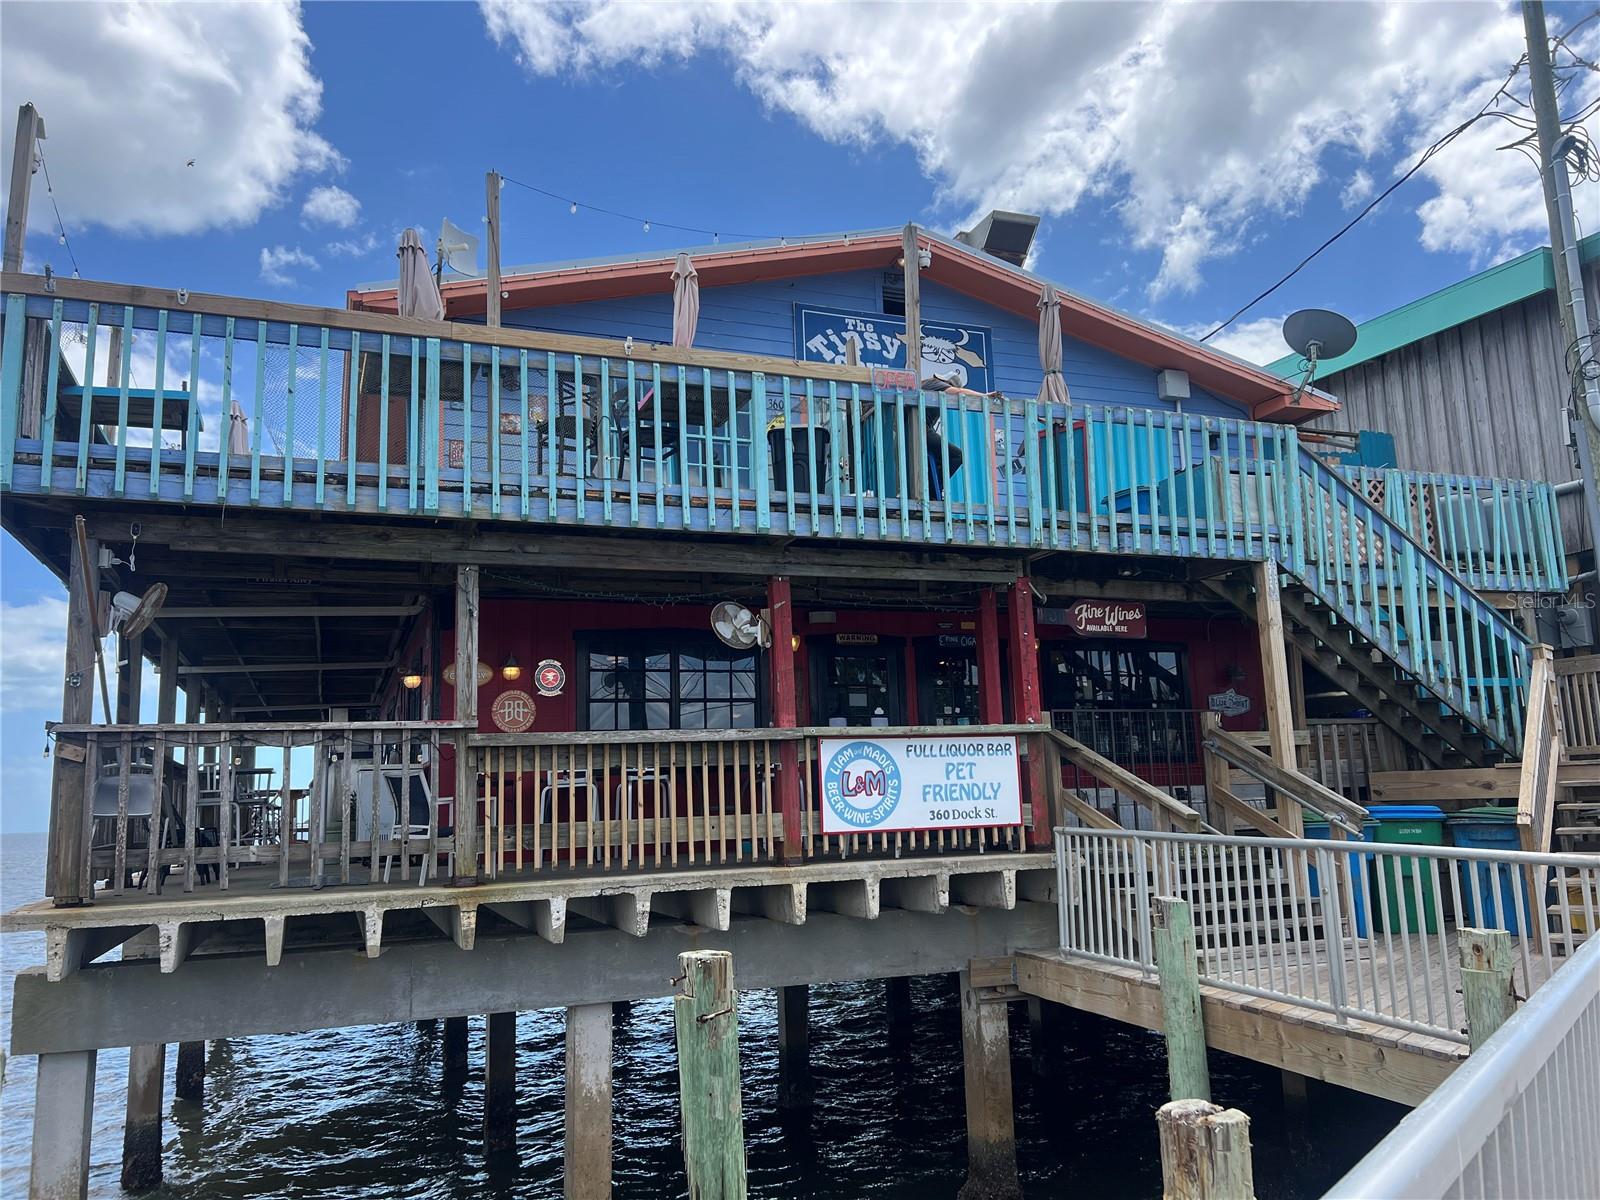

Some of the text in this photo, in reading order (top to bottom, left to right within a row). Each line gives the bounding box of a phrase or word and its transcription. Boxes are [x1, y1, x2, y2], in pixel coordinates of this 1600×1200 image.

[845, 318, 874, 333] The
[806, 328, 901, 363] Tipsy
[874, 369, 917, 390] OPEN
[768, 398, 784, 410] 360
[1074, 604, 1143, 630] Fine Wines
[838, 633, 876, 641] WARNING
[1086, 624, 1128, 633] AVAILABLE HERE
[905, 742, 1012, 758] FULL LIQUOR BAR
[830, 748, 854, 776] LIAM
[862, 745, 895, 775] MADI'S
[945, 762, 977, 781] PET
[841, 770, 886, 797] L&M
[922, 782, 1001, 803] FRIENDLY
[827, 779, 899, 824] BEER WINE SPIRITS
[929, 806, 998, 821] 360 Dock St.
